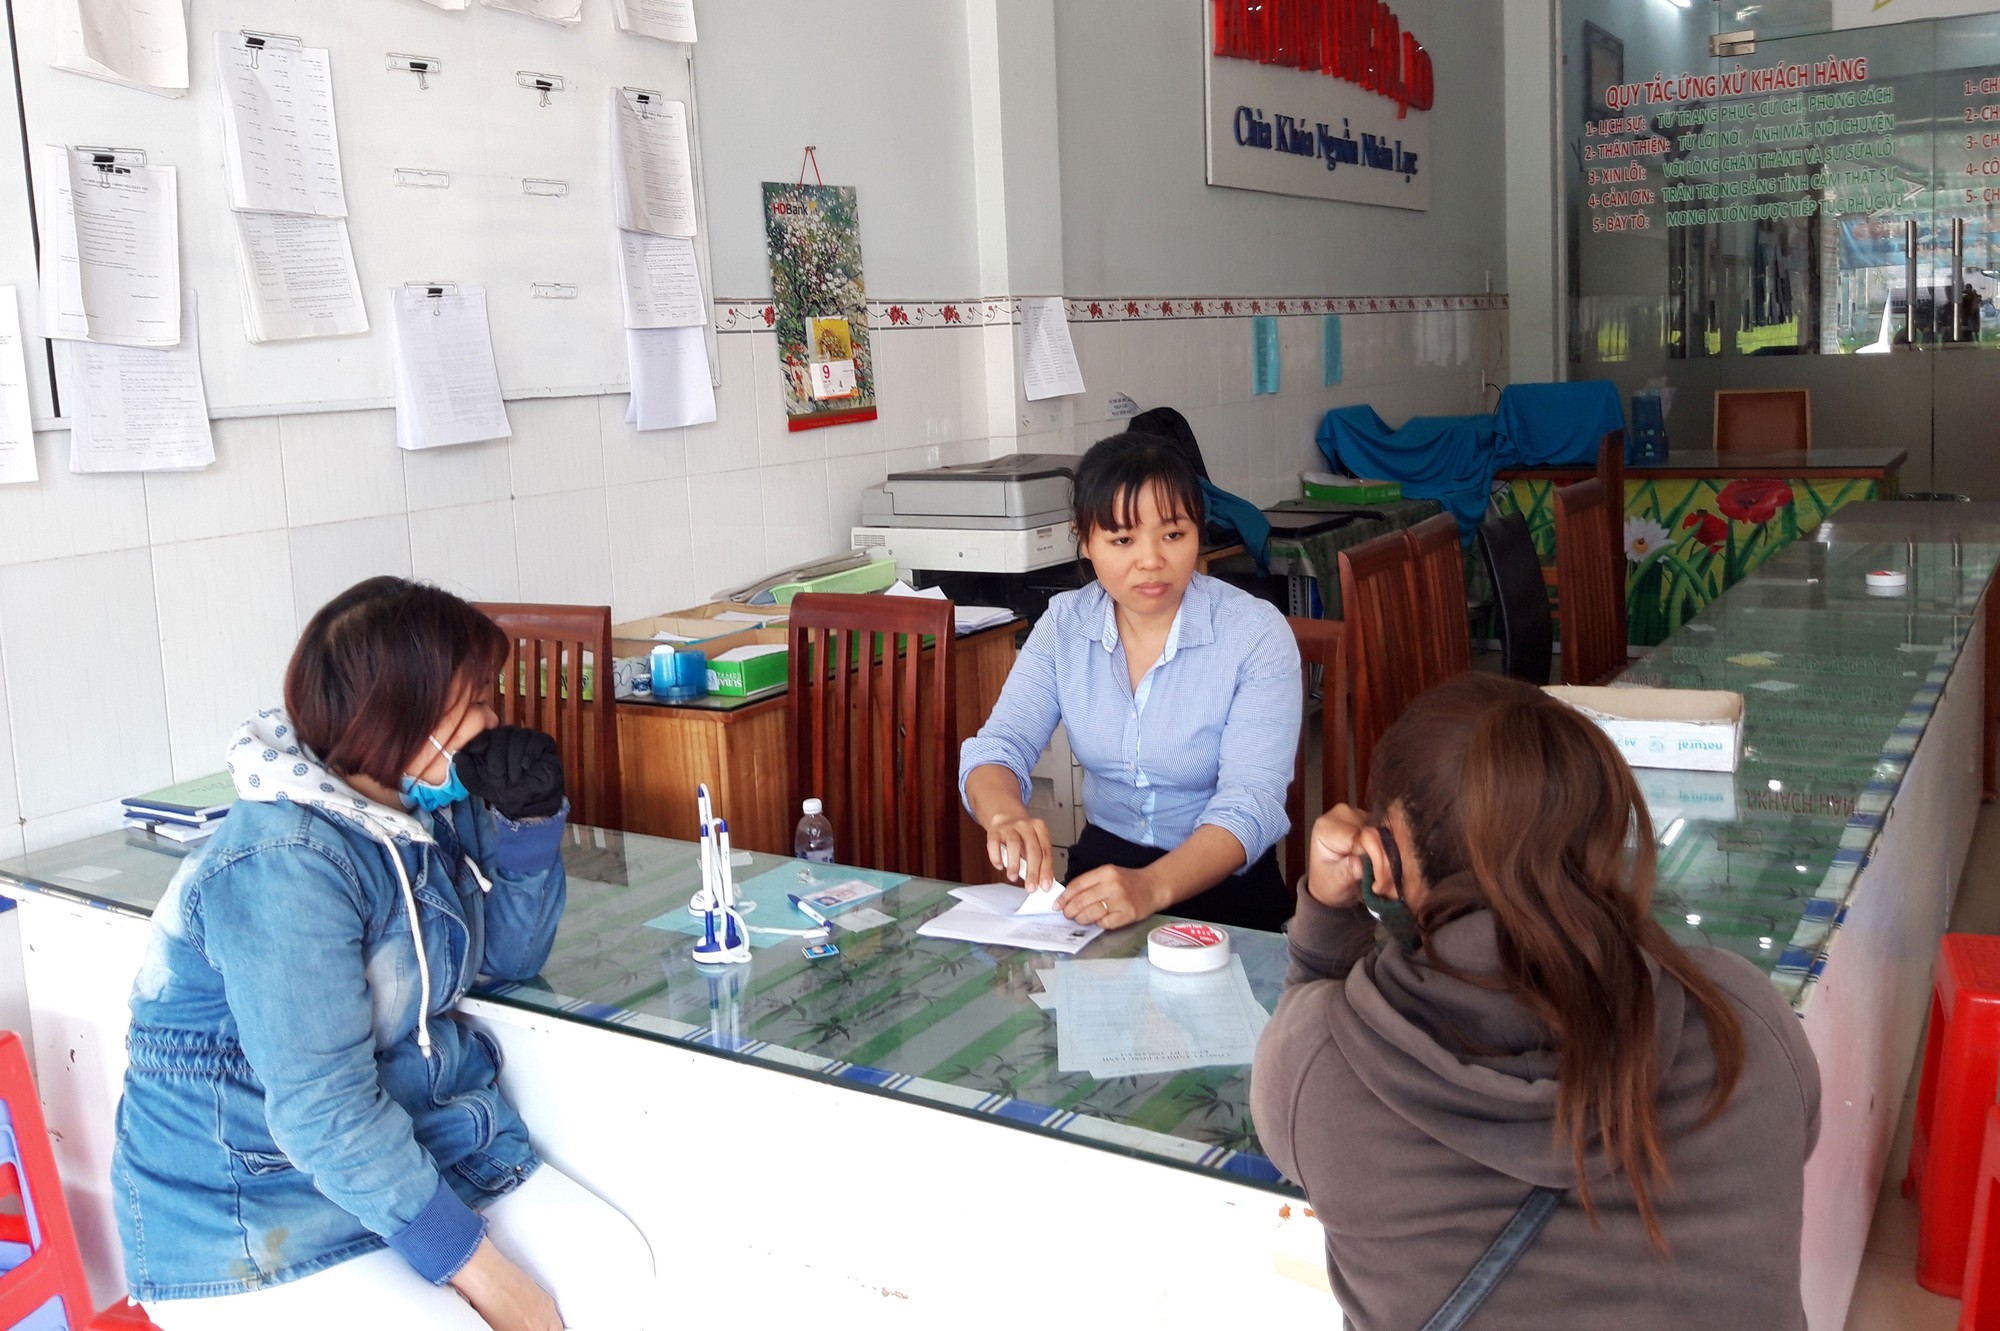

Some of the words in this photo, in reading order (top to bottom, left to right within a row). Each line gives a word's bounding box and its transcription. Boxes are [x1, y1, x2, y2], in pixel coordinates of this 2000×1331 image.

[1606, 83, 1641, 110] QUY
[1644, 71, 1673, 104] TẮC
[1678, 71, 1716, 101] ỨNG
[1720, 64, 1747, 96] XỬ
[1751, 61, 1808, 92] KHÁCH
[1814, 55, 1867, 86] HÀNG
[1599, 117, 1624, 138] LỊCH
[1677, 107, 1718, 127] TRANG
[1809, 91, 1855, 112] PHONG
[1857, 85, 1893, 106] CÁCH
[1598, 138, 1631, 159] THÂN
[1632, 135, 1671, 157] THIỆN:
[1699, 129, 1717, 149] LỜI
[1752, 123, 1779, 144] ÁNH
[1815, 116, 1839, 137] NÓI
[1841, 111, 1895, 135] CHUYỆN
[1602, 167, 1621, 184] XIN
[1662, 158, 1685, 178] VỚI
[1687, 156, 1719, 176] LÒNG
[1722, 151, 1757, 172] CHÂN
[1758, 148, 1801, 169] THÀNH
[1804, 144, 1822, 165] VÀ
[1825, 146, 1844, 165] SỰ
[1602, 187, 1629, 208] CẢM
[1661, 183, 1693, 203] TRÂN
[1695, 181, 1739, 202] TRỌNG
[1778, 172, 1809, 192] TÌNH
[772, 202, 809, 216] HDBank
[1606, 212, 1628, 232] BÀY
[1666, 208, 1706, 227] MONG
[1751, 201, 1788, 223] ĐƯỢC
[1790, 195, 1817, 217] TIẾP
[1845, 195, 1884, 215] PHỤC
[822, 364, 831, 379] 9
[1678, 741, 1723, 752] natural
